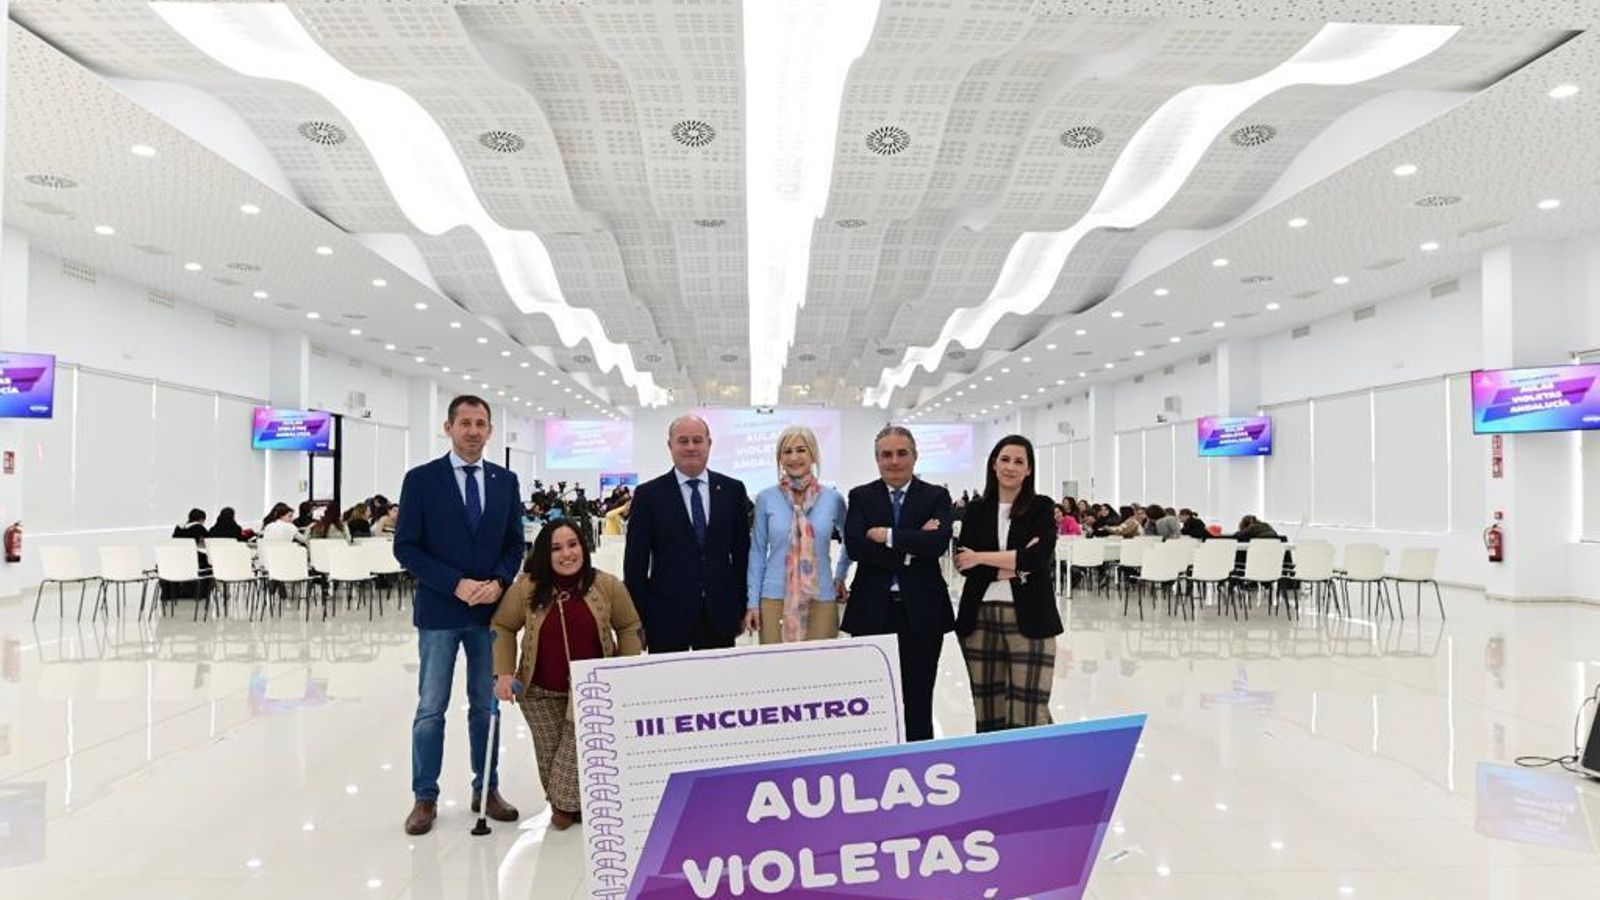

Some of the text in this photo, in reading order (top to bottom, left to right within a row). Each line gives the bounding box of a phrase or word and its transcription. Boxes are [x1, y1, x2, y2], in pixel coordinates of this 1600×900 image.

[745, 431, 778, 442] AULA
[635, 697, 870, 737] III ENCUENTRO
[746, 763, 961, 823] AULAS
[682, 829, 1000, 899] VIOLETAS
